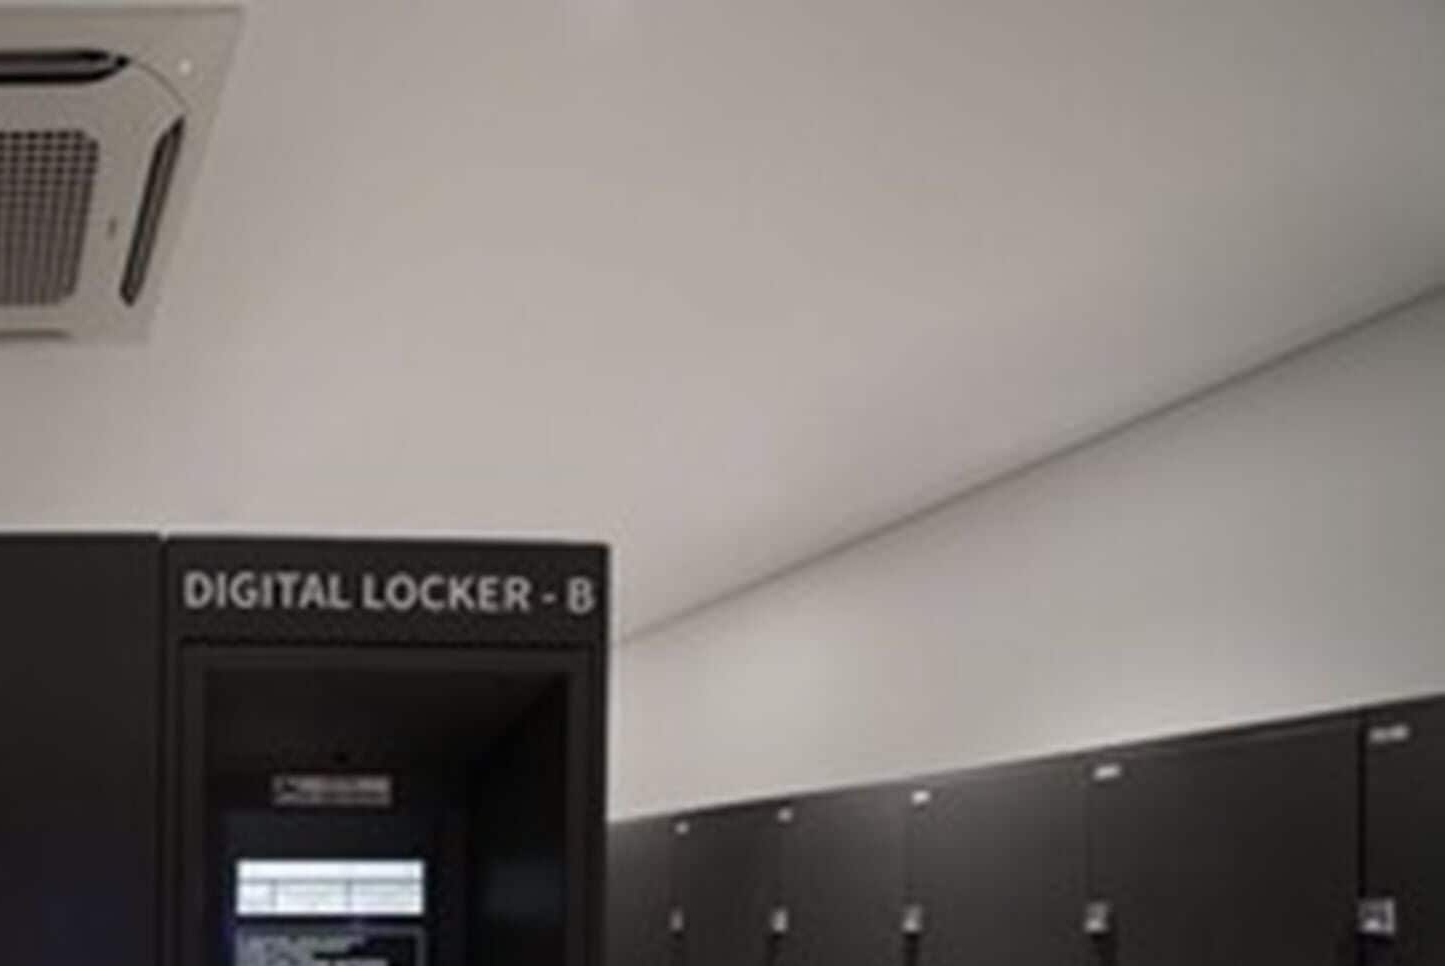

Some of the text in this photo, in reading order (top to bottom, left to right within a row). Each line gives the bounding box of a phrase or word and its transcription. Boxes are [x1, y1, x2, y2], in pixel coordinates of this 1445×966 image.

[183, 570, 353, 609] DIGITAL
[361, 573, 532, 613] LOCKER
[566, 576, 596, 614] B
